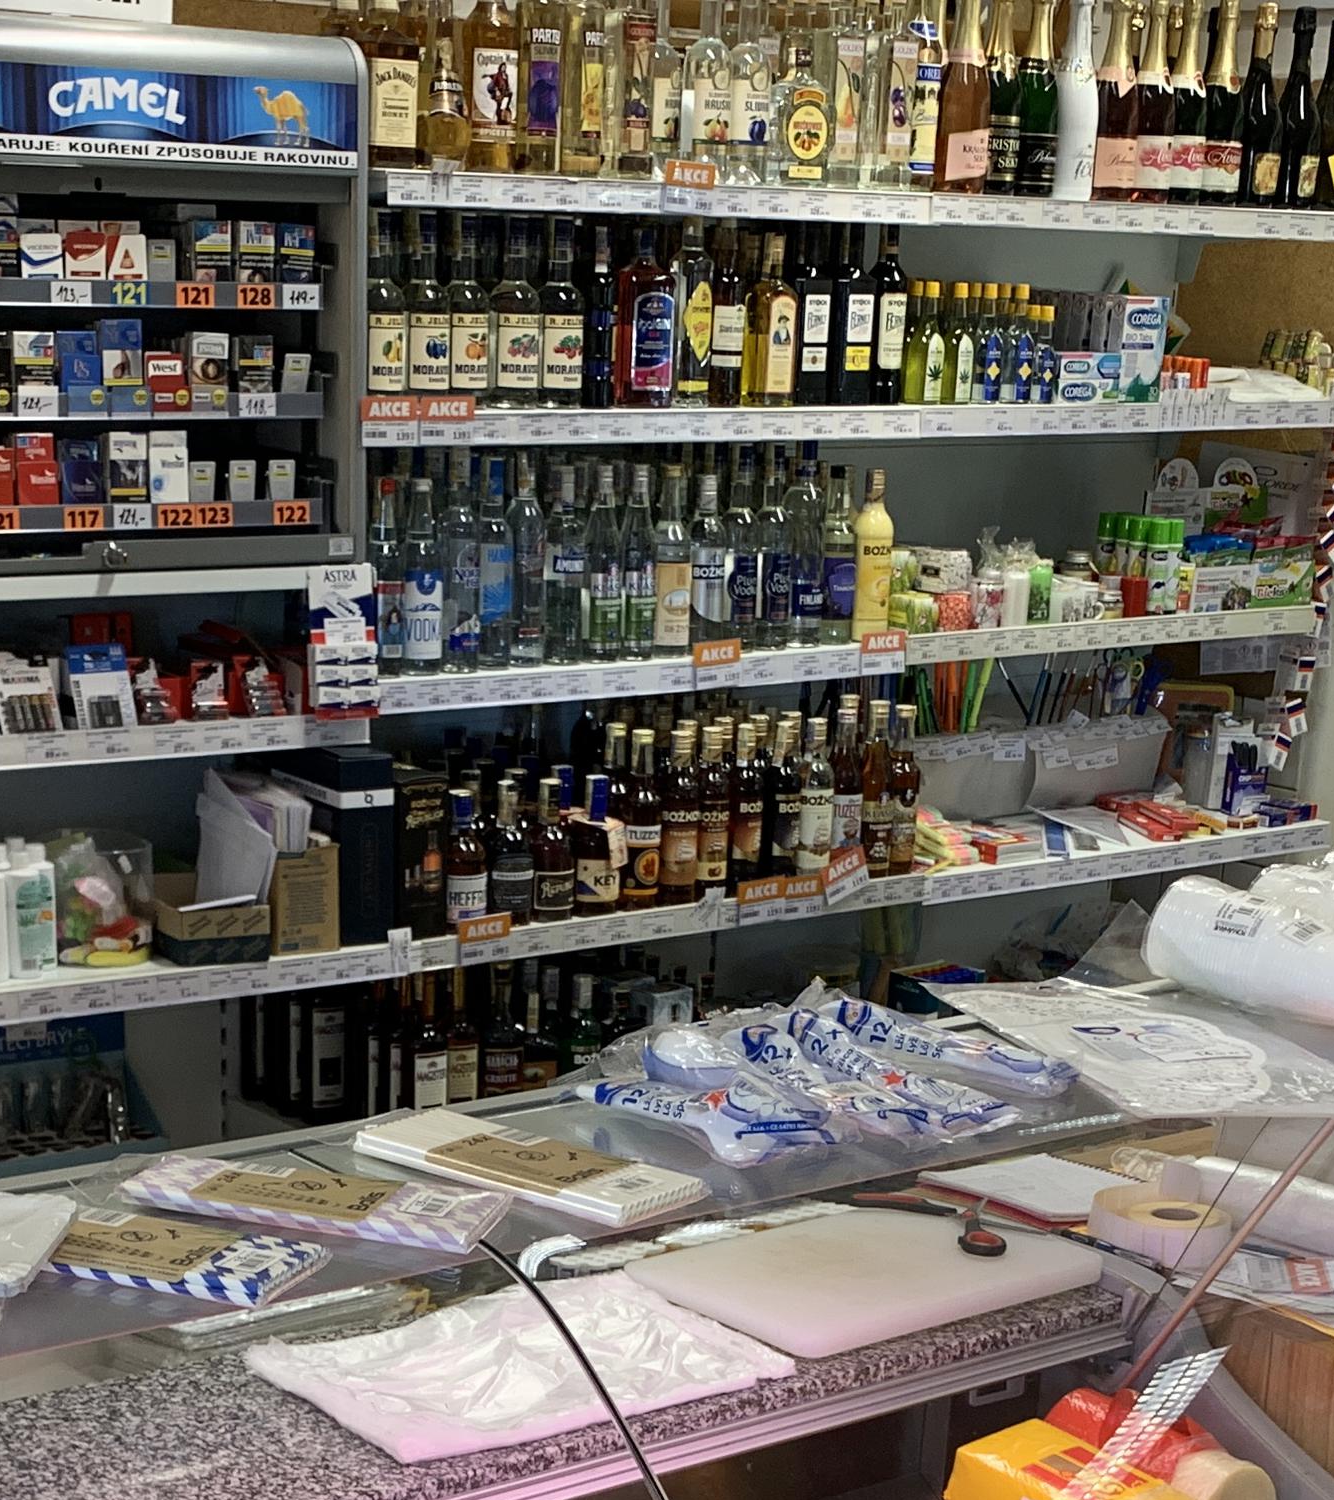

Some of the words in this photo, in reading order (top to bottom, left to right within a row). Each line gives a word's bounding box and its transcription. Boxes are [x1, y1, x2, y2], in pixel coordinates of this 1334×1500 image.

[48, 77, 186, 125] CAMEL
[69, 141, 149, 156] KOUŘENÍ
[156, 145, 257, 161] ZPŮSOBUJE
[264, 152, 355, 167] RAKOVINU.
[673, 161, 710, 186] AKCE
[112, 282, 146, 305] 121
[181, 286, 211, 306] 121
[240, 287, 271, 306] 128
[1131, 313, 1163, 327] COREGA
[151, 362, 178, 373] West
[1061, 385, 1095, 399] COREGA
[369, 402, 411, 417] AKCE
[428, 402, 468, 417] AKCE
[68, 510, 99, 528] 117
[161, 509, 192, 526] 122
[198, 507, 230, 525] 123
[277, 506, 307, 523] 122
[324, 570, 357, 583] ASTRA
[868, 635, 901, 652] AKCE
[701, 646, 735, 662] AKCE
[828, 854, 861, 883] AKCE
[594, 874, 617, 887] KEY
[785, 878, 818, 894] AKCE
[744, 883, 779, 898] AKCE
[468, 921, 503, 937] AKCE
